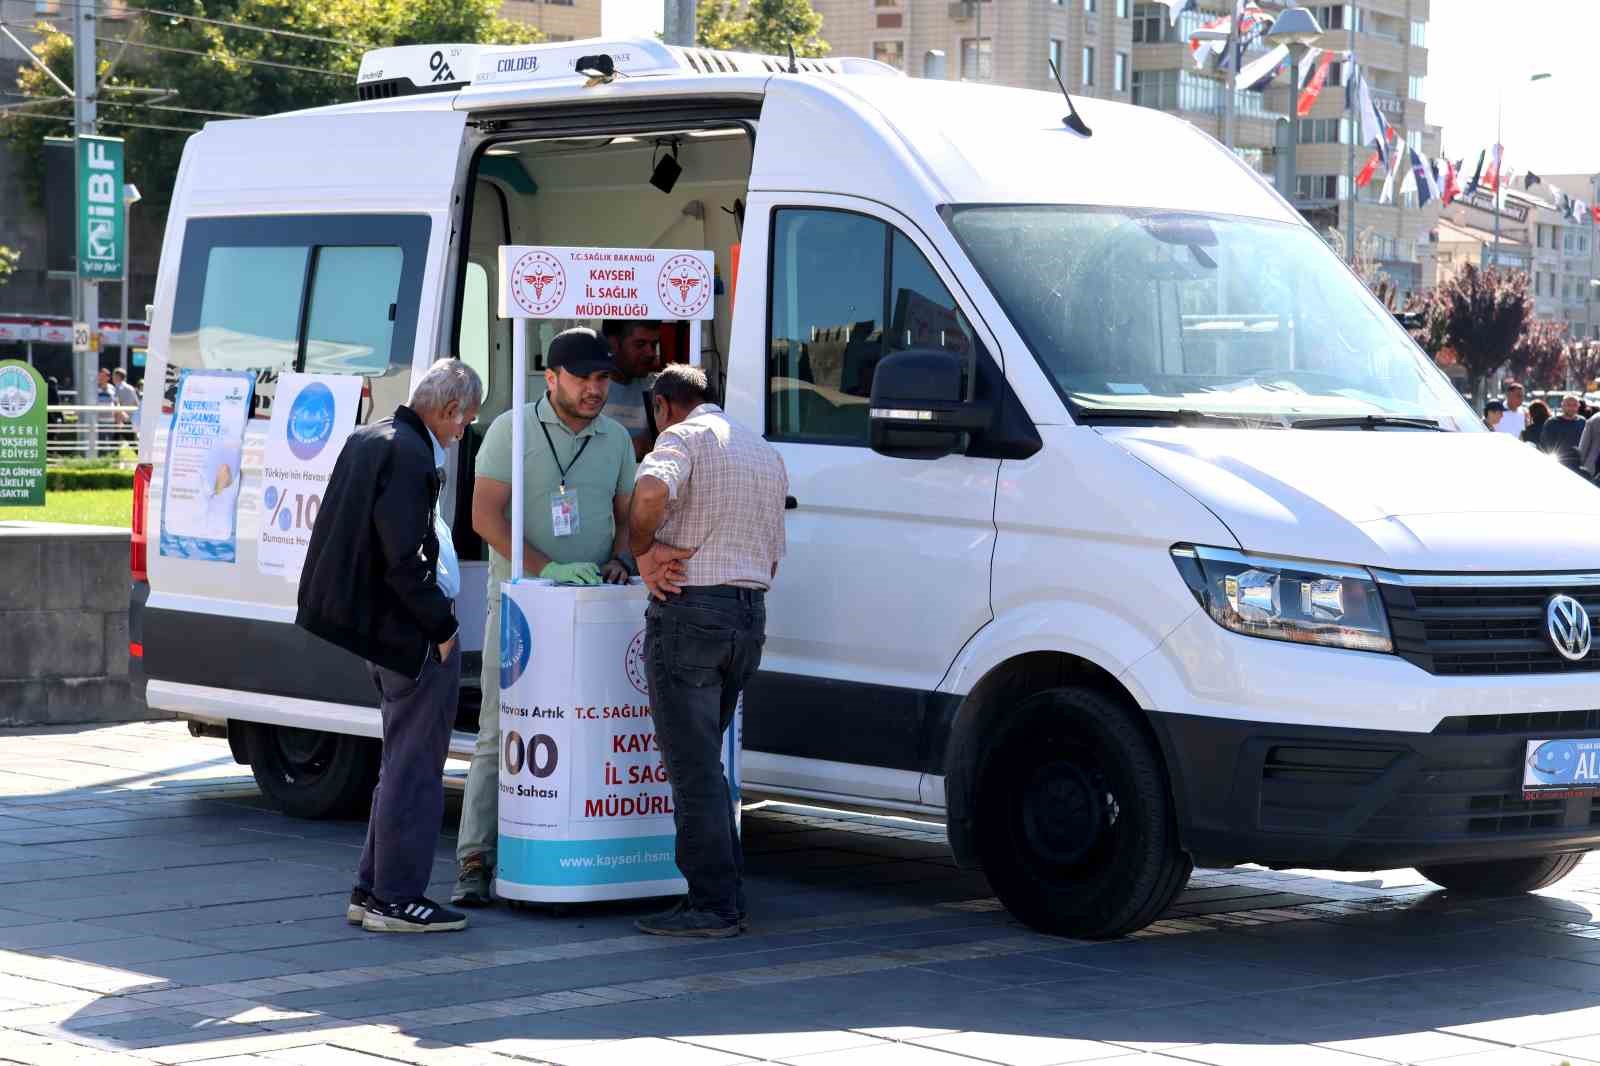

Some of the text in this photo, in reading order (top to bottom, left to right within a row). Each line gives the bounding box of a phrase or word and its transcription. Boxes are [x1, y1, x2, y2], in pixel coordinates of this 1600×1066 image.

[498, 56, 537, 72] COLDER
[570, 252, 655, 262] T.C. SAĞLIK BAKANLIĞI
[590, 266, 635, 281] KAYSERİ
[585, 284, 638, 299] İL SAĞLIK
[575, 303, 648, 317] MÜDÜRLÜĞÜ
[75, 329, 88, 345] 20
[25, 479, 36, 487] VE
[531, 706, 565, 719] Artık
[575, 707, 600, 720] T.C.
[499, 730, 559, 778] 00
[1574, 751, 1600, 779] AL
[605, 762, 622, 785] İL
[517, 784, 559, 799] Sahası
[584, 792, 674, 818] MÜDÜRL
